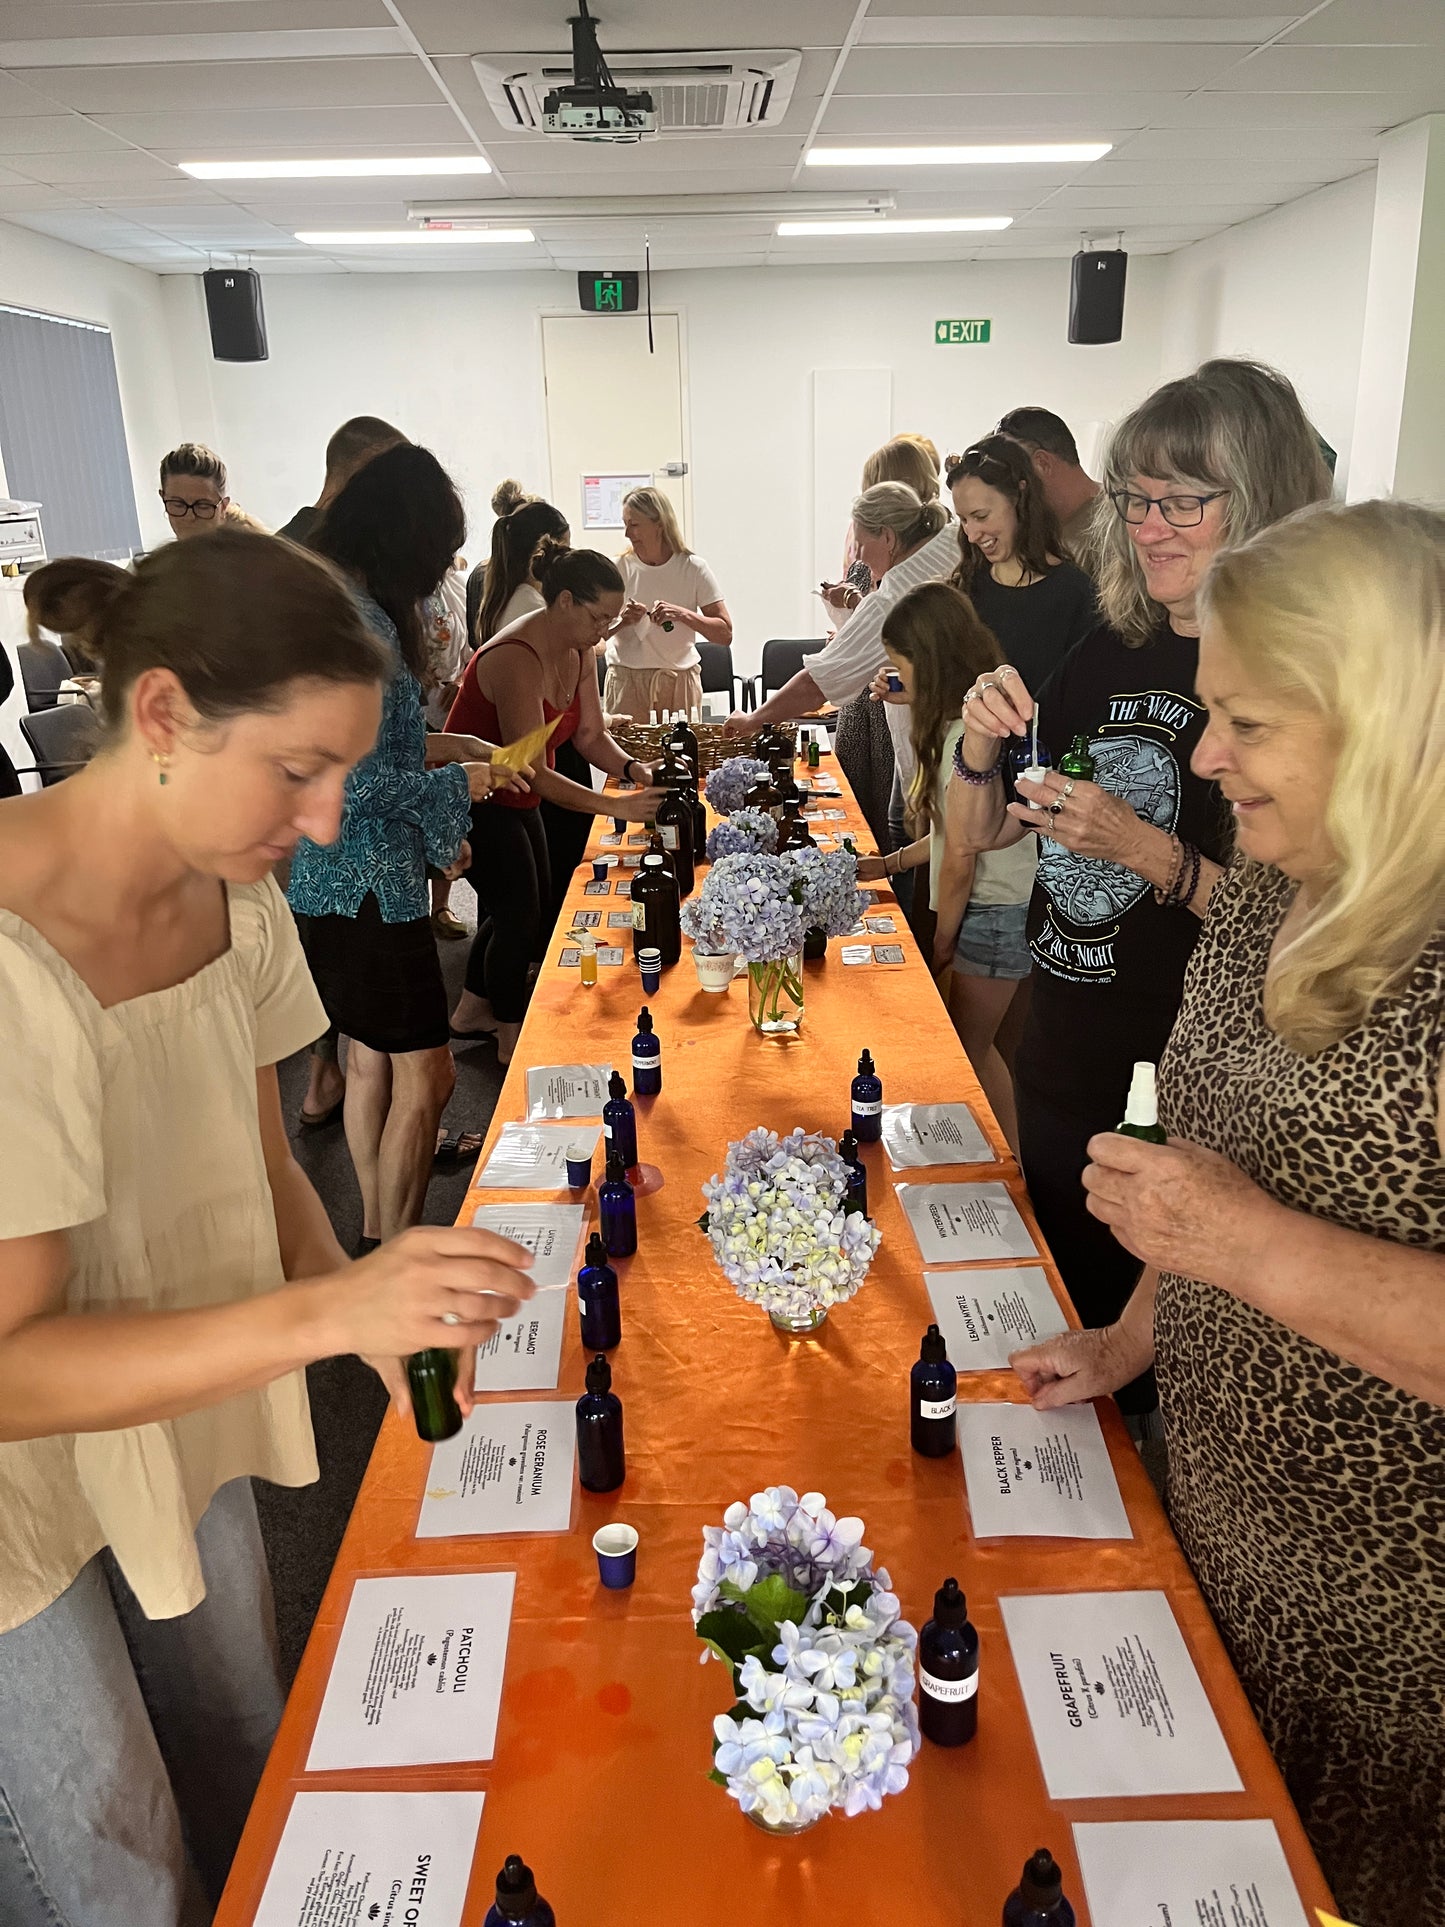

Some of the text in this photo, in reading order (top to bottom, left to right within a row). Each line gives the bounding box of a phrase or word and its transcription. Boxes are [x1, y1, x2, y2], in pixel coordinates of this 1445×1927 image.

[950, 321, 985, 341] EXIT
[1109, 695, 1194, 729] THE WAIFS
[1044, 935, 1071, 963] ALL
[1071, 943, 1114, 967] NIGHT
[926, 1203, 948, 1238] WINTERGREEN
[542, 1229, 556, 1256] LAVENDER
[955, 1295, 980, 1341] LEMON MYRTLE
[526, 1321, 538, 1354] BERGAMOT
[530, 1429, 546, 1495] ROSE GERANIUM
[990, 1436, 1010, 1493] BLACK PEPPER
[435, 1629, 454, 1693] (Pogostemon cablin)
[452, 1627, 474, 1693] PATCHOULI
[922, 1676, 968, 1695] GRAPEFRUIT
[1049, 1651, 1083, 1727] GRAPEFRUIT
[386, 1879, 402, 1909] (Citrus
[407, 1854, 431, 1903] SWEET
